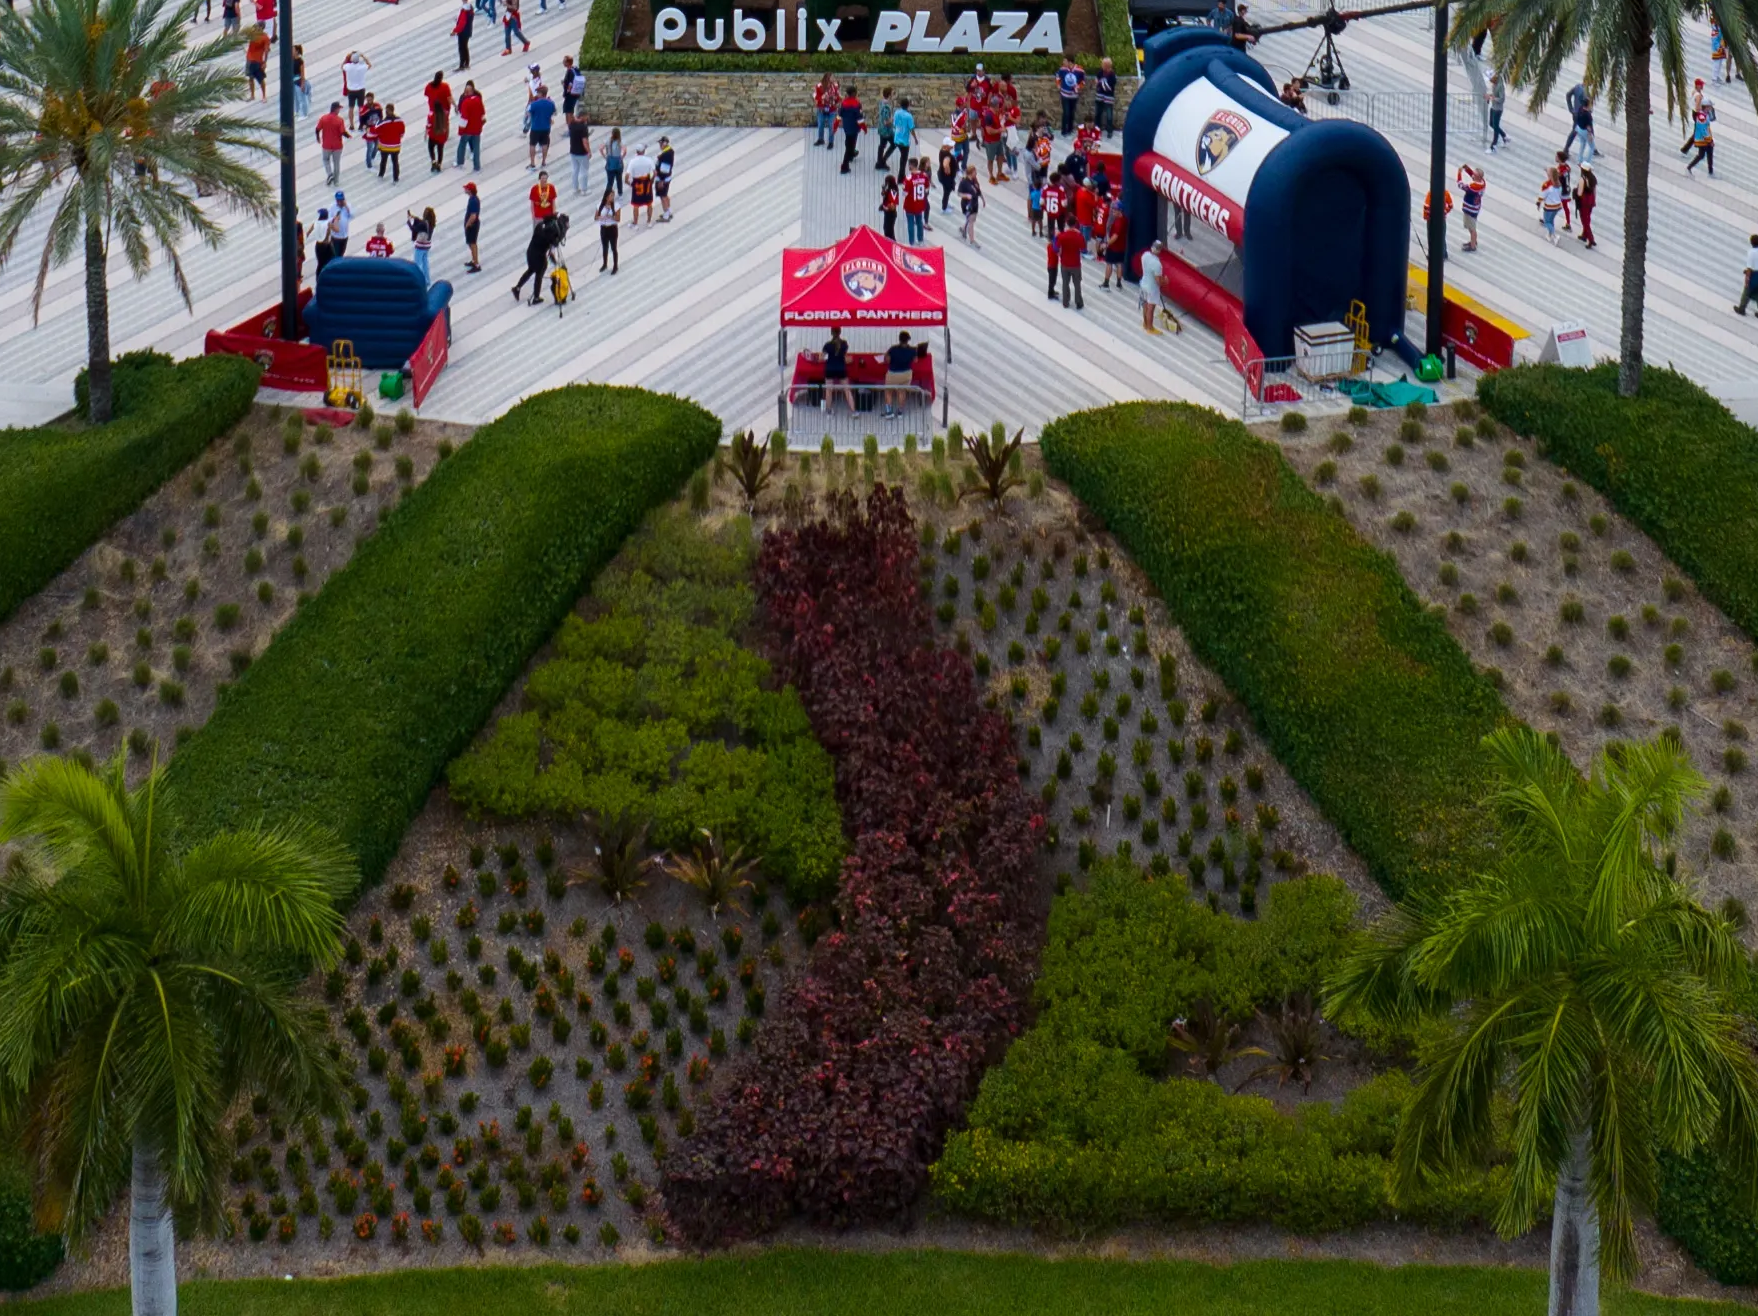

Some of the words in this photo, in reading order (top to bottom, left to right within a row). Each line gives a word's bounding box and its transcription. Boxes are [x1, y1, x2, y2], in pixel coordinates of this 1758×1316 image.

[654, 6, 843, 52] Publix
[870, 9, 1064, 53] PLAZA
[912, 184, 925, 201] 19
[1150, 162, 1231, 239] PANTHERS
[1046, 197, 1058, 213] 16
[843, 260, 882, 272] FLORIDA
[784, 310, 851, 321] FLORIDA
[856, 309, 943, 321] PANTHERS
